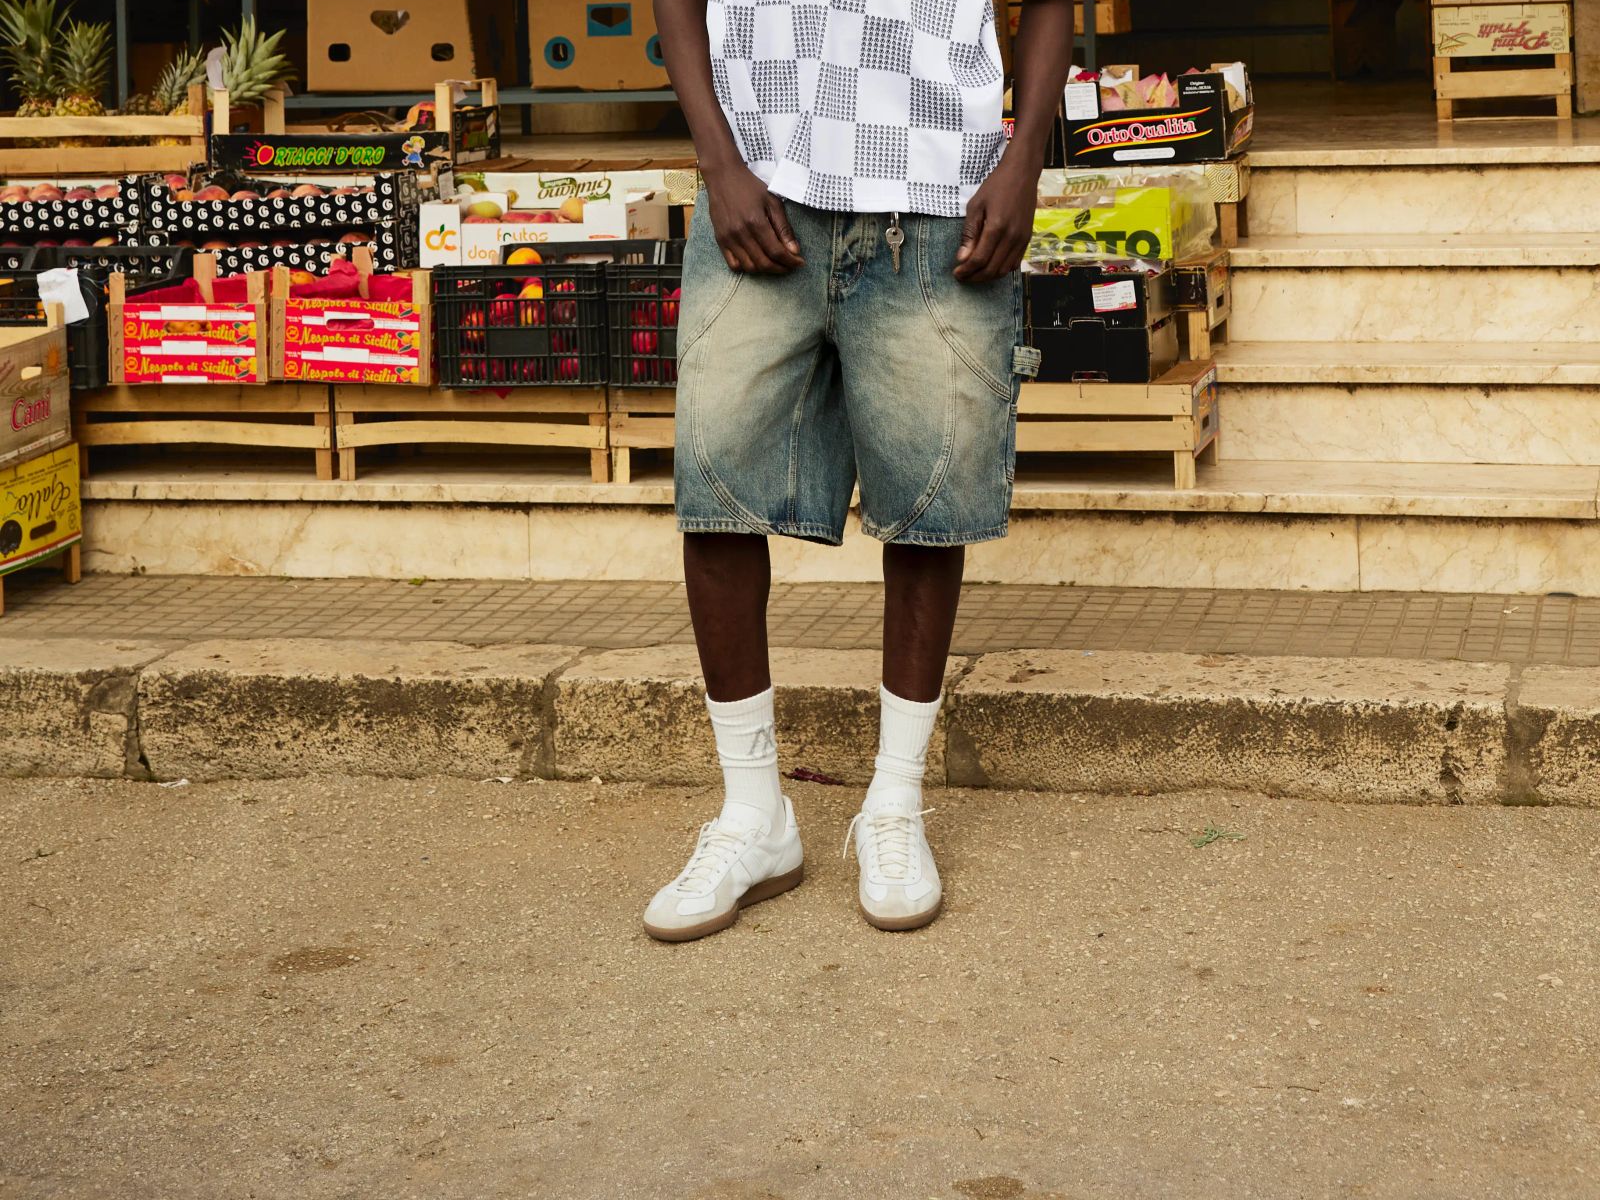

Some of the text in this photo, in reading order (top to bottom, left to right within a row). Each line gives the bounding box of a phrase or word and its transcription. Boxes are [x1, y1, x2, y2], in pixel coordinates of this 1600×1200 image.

[336, 146, 386, 166] D'ORO
[537, 179, 612, 200] Giuliano
[496, 227, 549, 243] frutas
[349, 334, 361, 343] di
[363, 331, 401, 352] Sicilia
[187, 361, 199, 372] di
[201, 358, 237, 378] Sicilia
[17, 473, 71, 522] Gallo
